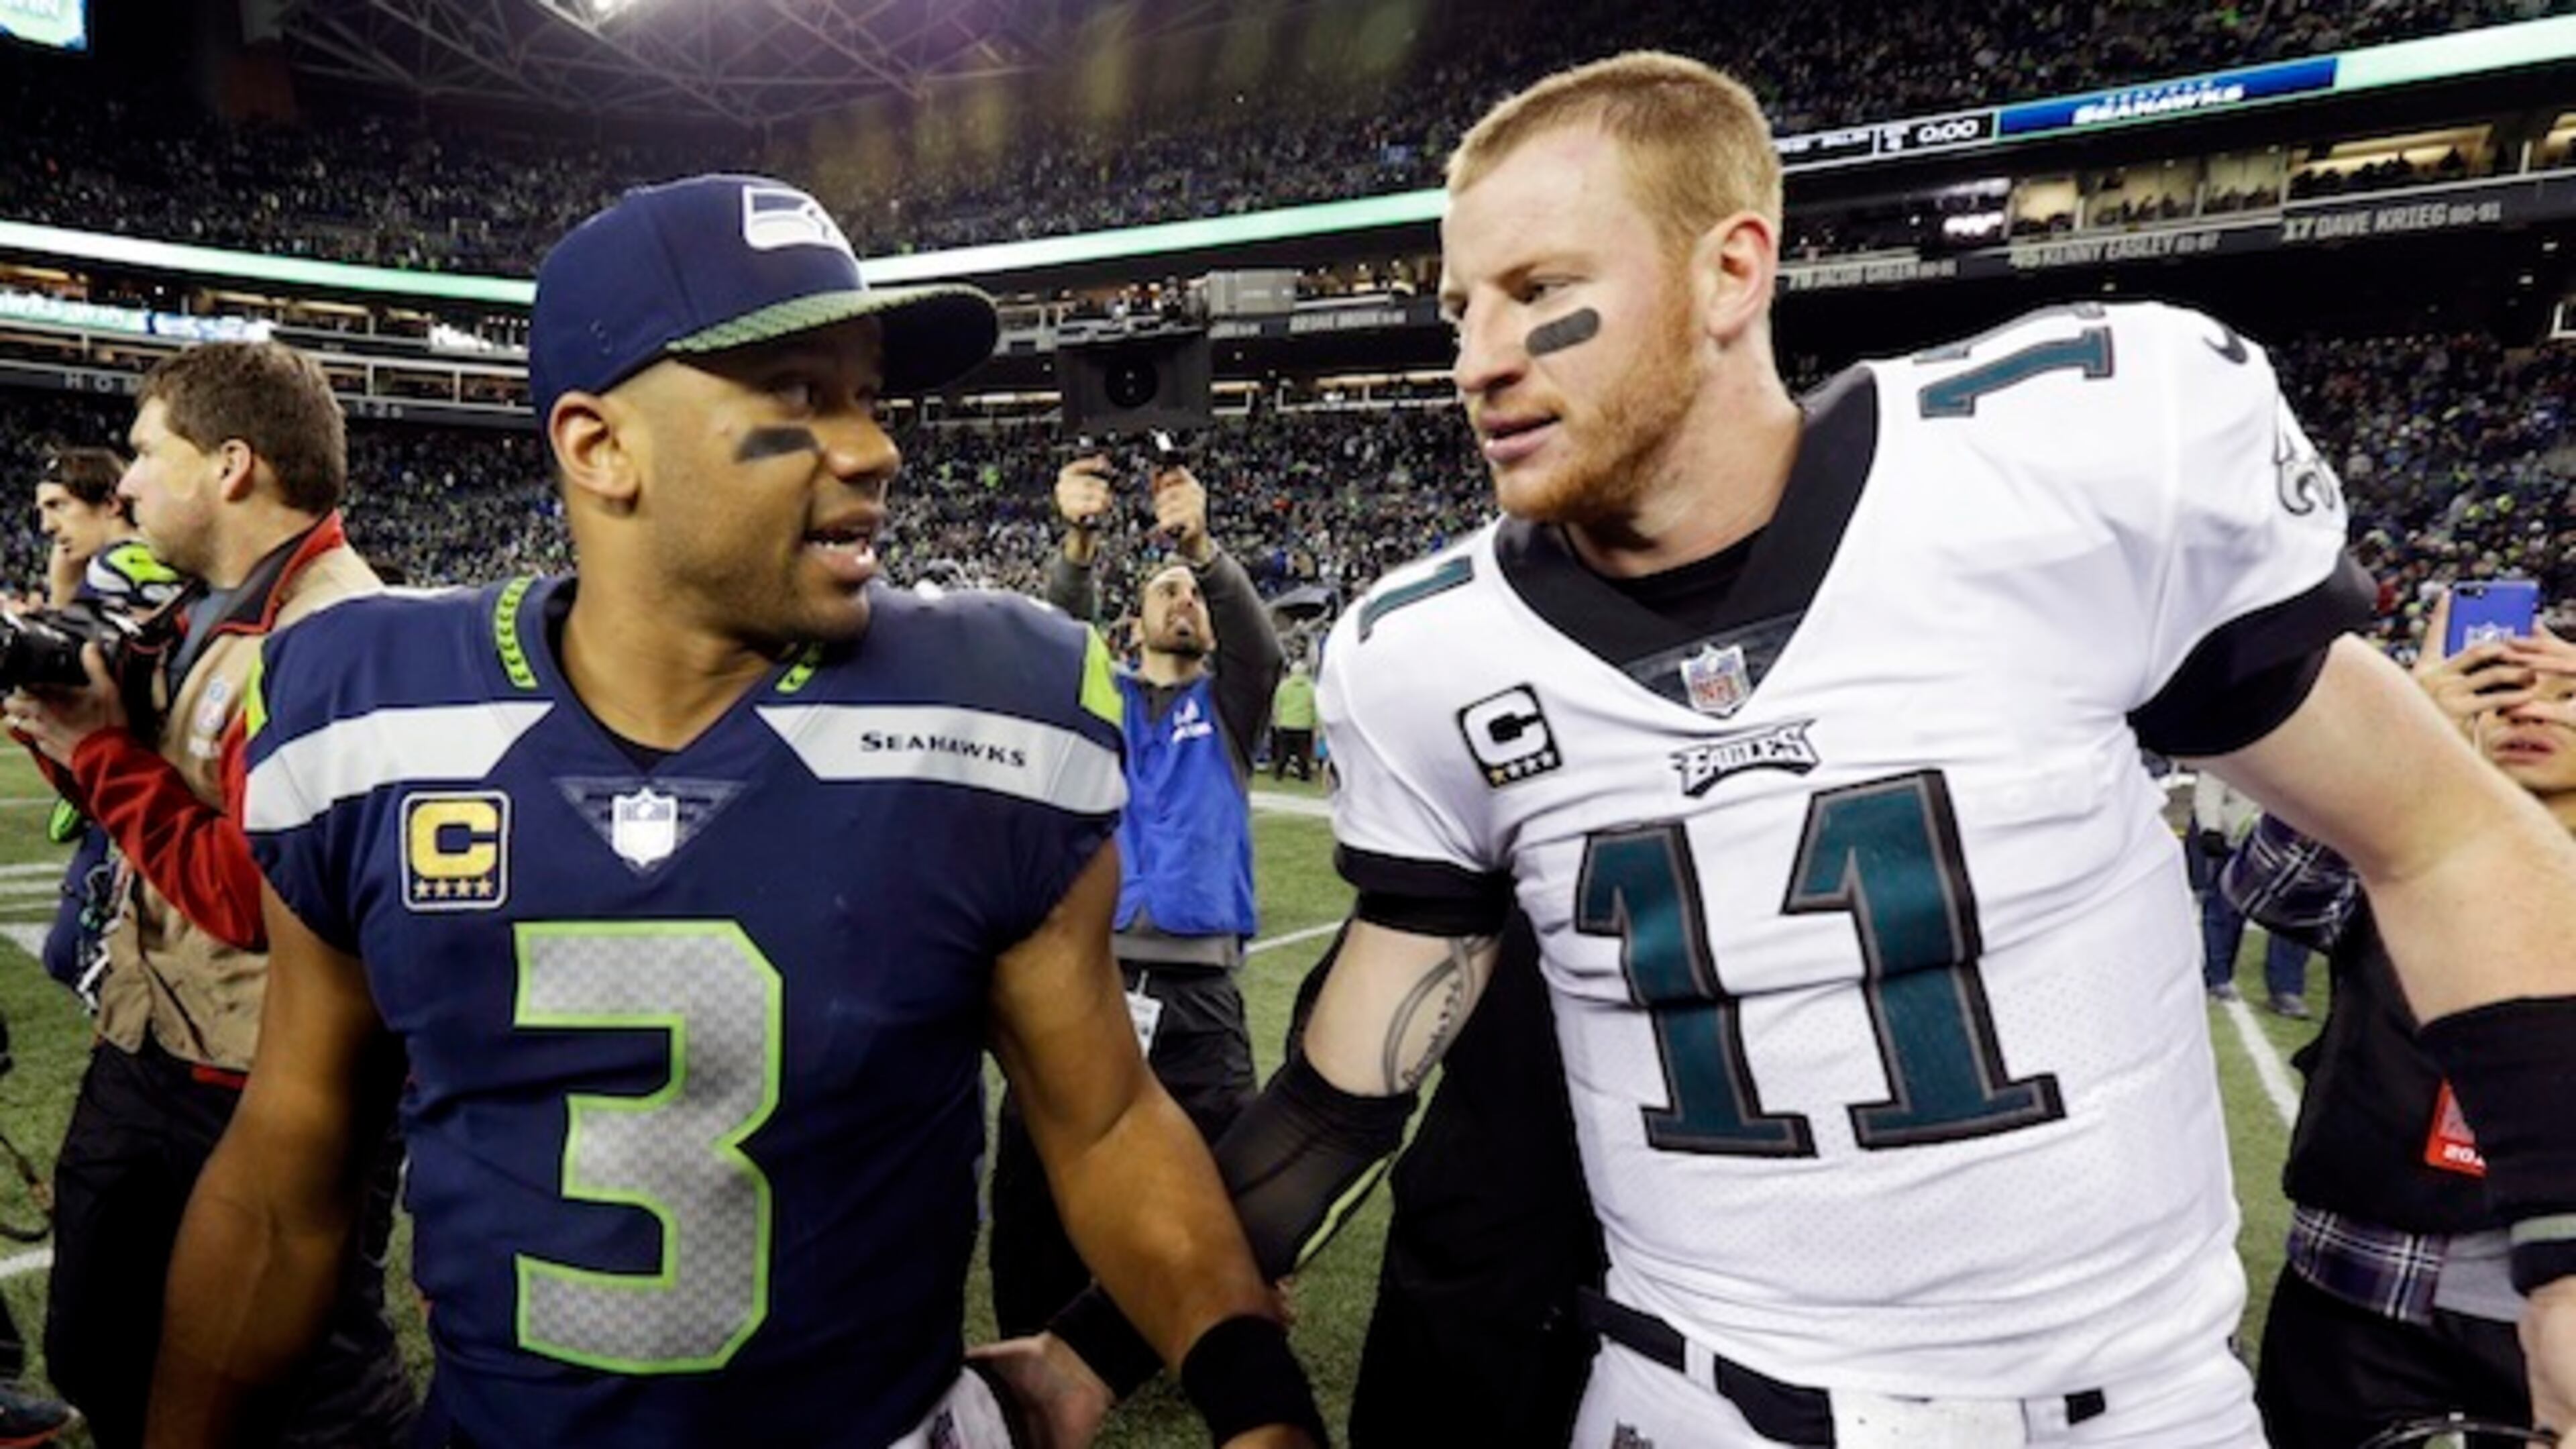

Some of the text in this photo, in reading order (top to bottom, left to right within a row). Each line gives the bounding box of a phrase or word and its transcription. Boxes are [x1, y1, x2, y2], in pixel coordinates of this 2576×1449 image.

[2072, 83, 2245, 126] SEAHAWKS
[2314, 211, 2373, 239] DAVE
[2373, 203, 2448, 233] KRIEG
[861, 730, 1026, 767] SEAHAWKS
[1464, 691, 1547, 767] C
[1669, 719, 1821, 798] EAGLES
[409, 800, 499, 879] C
[1574, 767, 2068, 1159] 11
[513, 920, 784, 1375] 3
